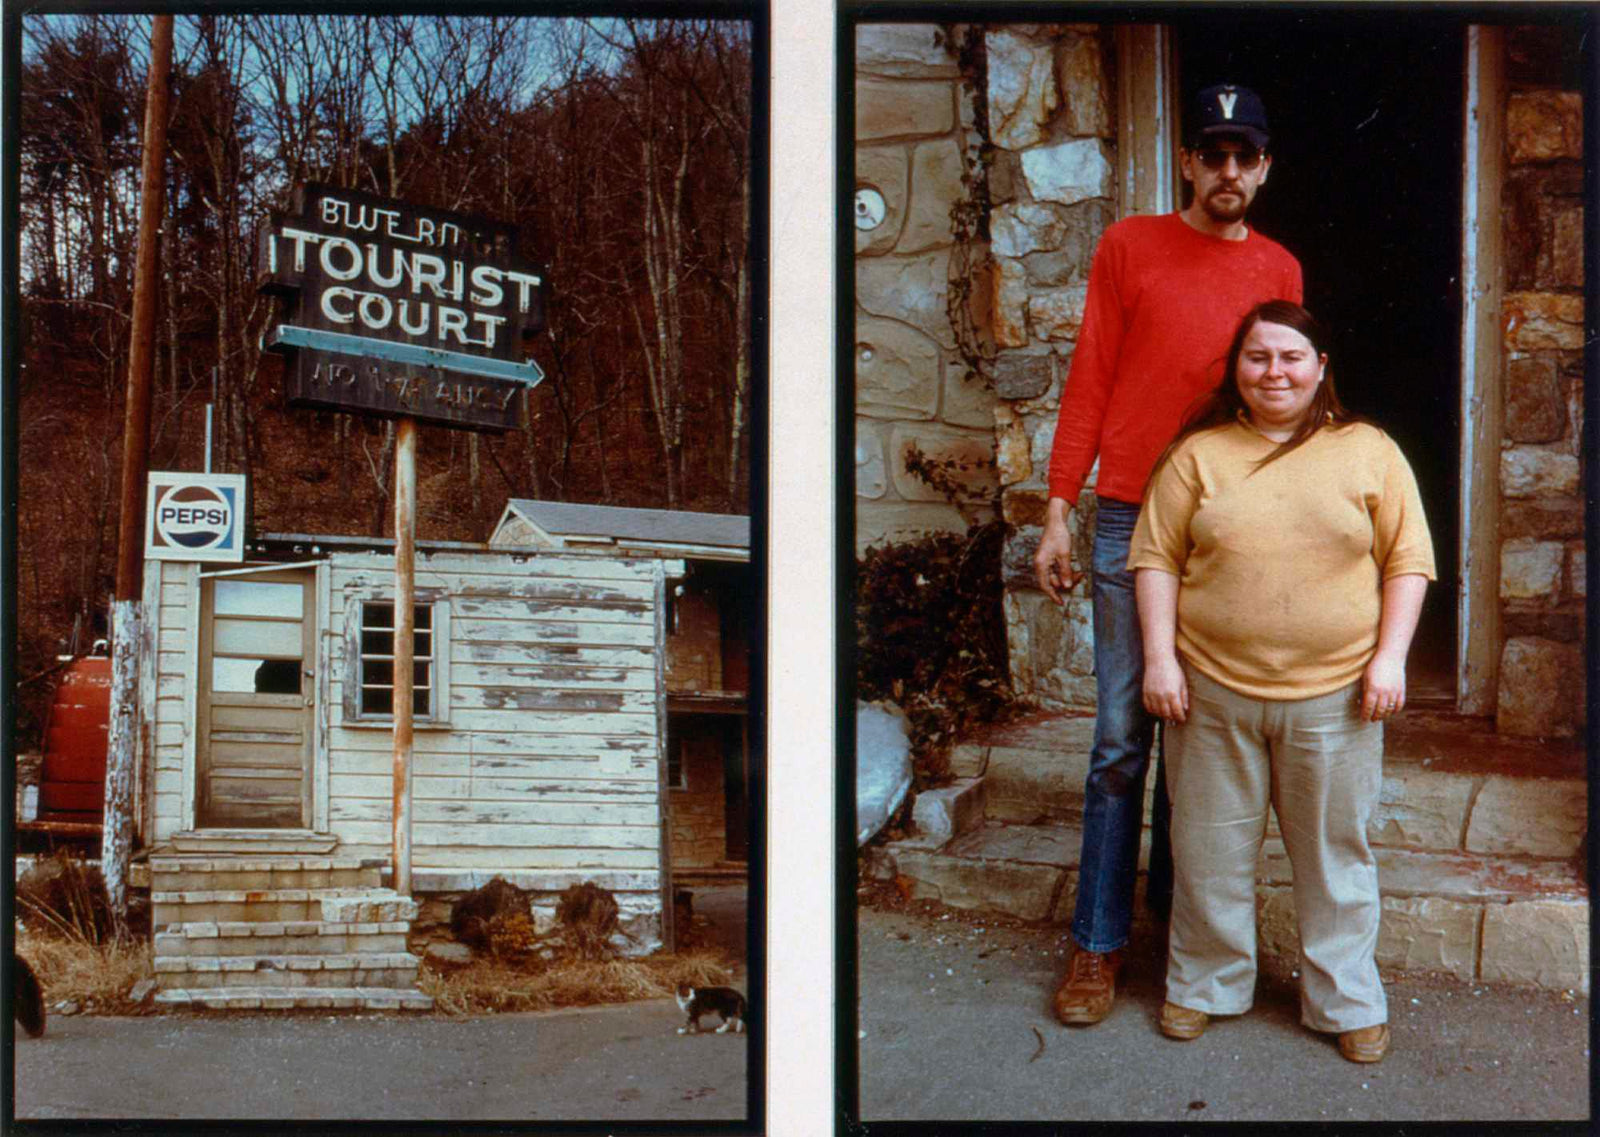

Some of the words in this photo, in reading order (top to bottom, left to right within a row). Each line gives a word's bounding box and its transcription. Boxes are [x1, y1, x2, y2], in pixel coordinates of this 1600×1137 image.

[321, 196, 401, 236] BLUE
[281, 226, 541, 314] TOURIST
[320, 285, 507, 348] COURT
[161, 507, 228, 526] PEPSI
